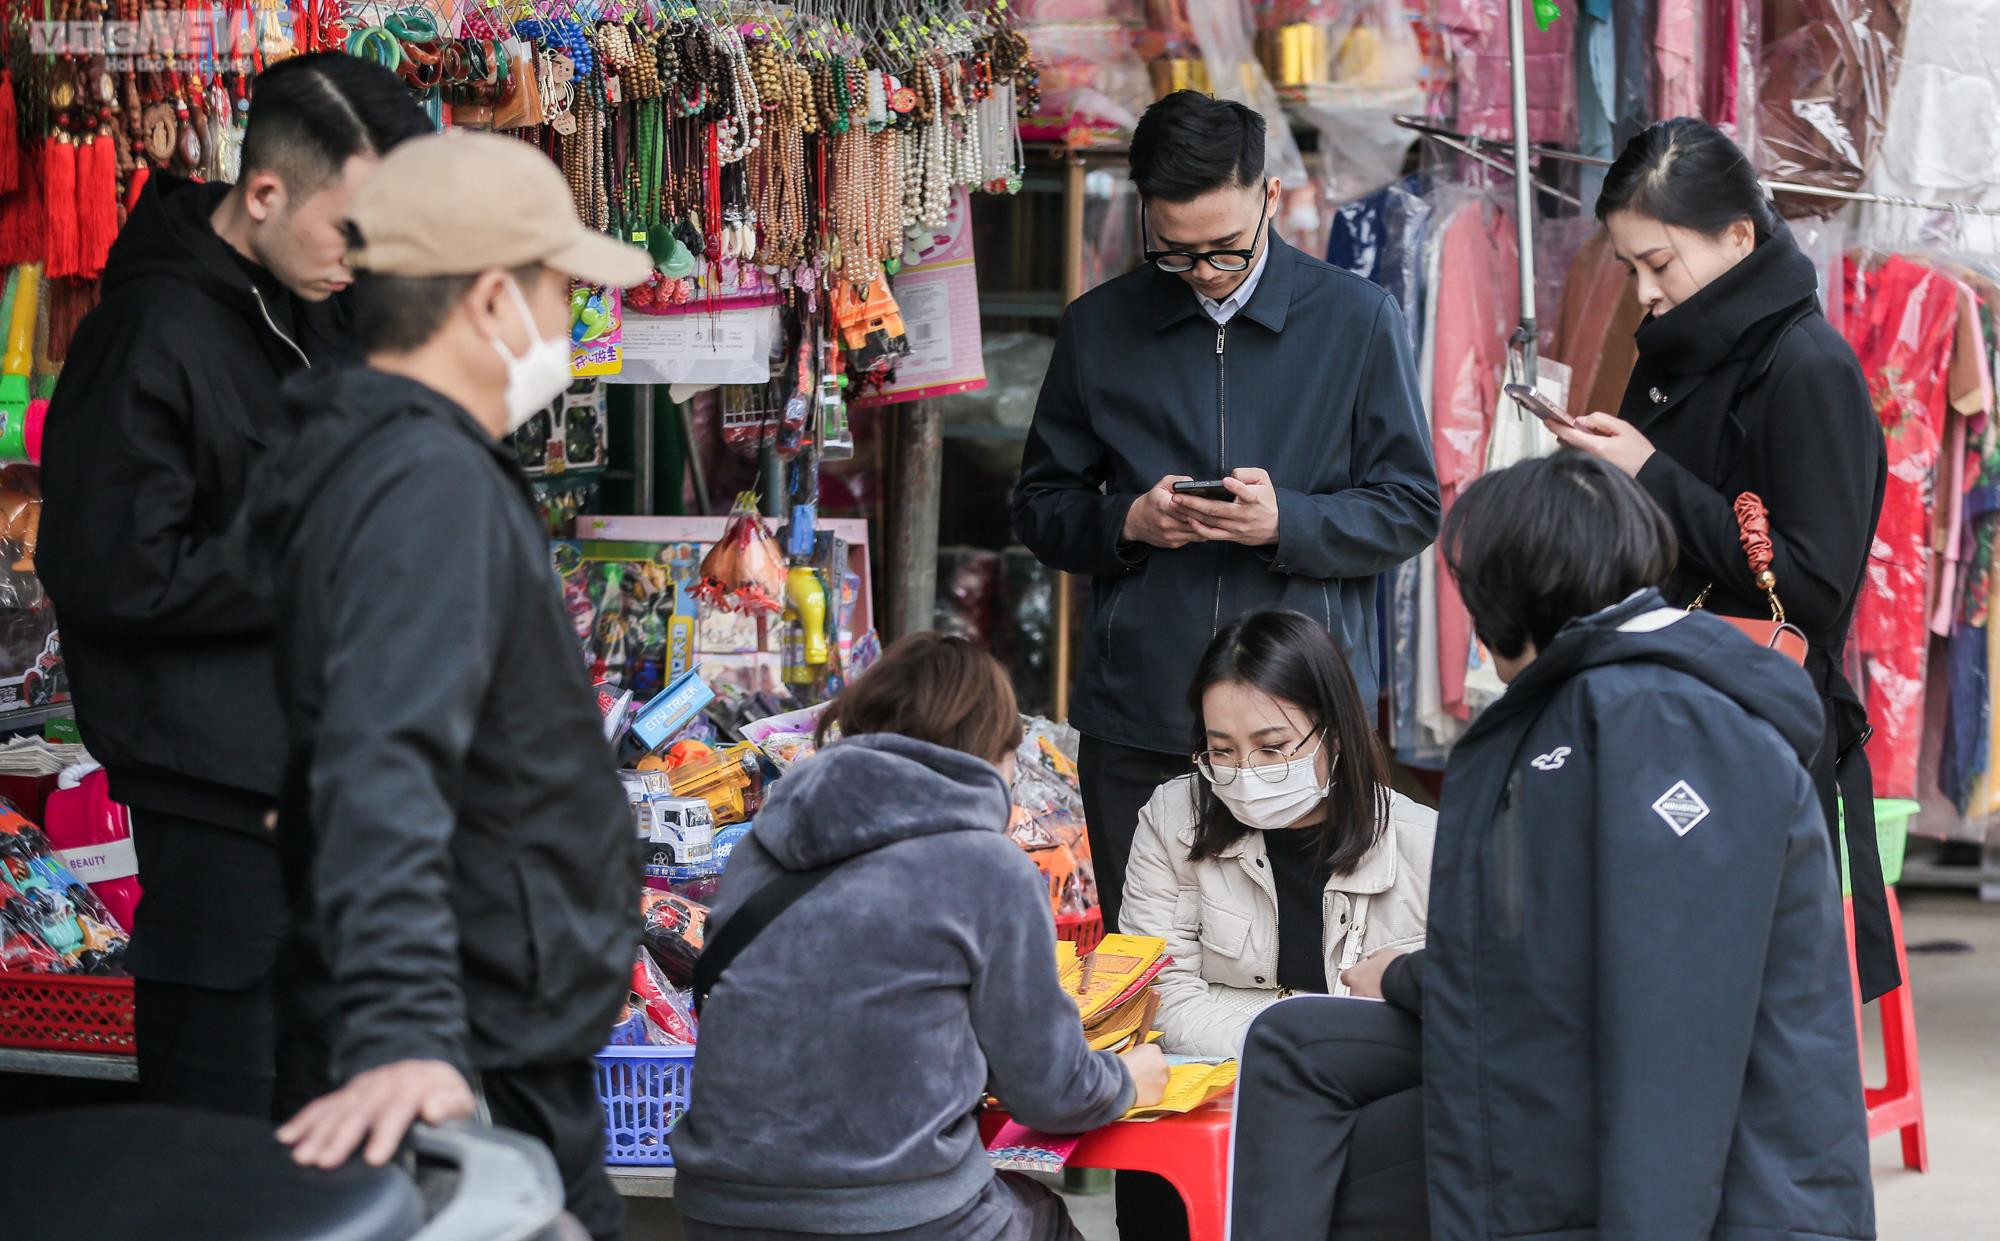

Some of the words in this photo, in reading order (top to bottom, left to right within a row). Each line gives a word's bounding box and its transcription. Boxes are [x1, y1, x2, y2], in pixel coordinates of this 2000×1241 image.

[644, 710, 668, 732] CITY
[669, 686, 698, 713] TRUCK
[69, 855, 106, 870] BEAUTY
